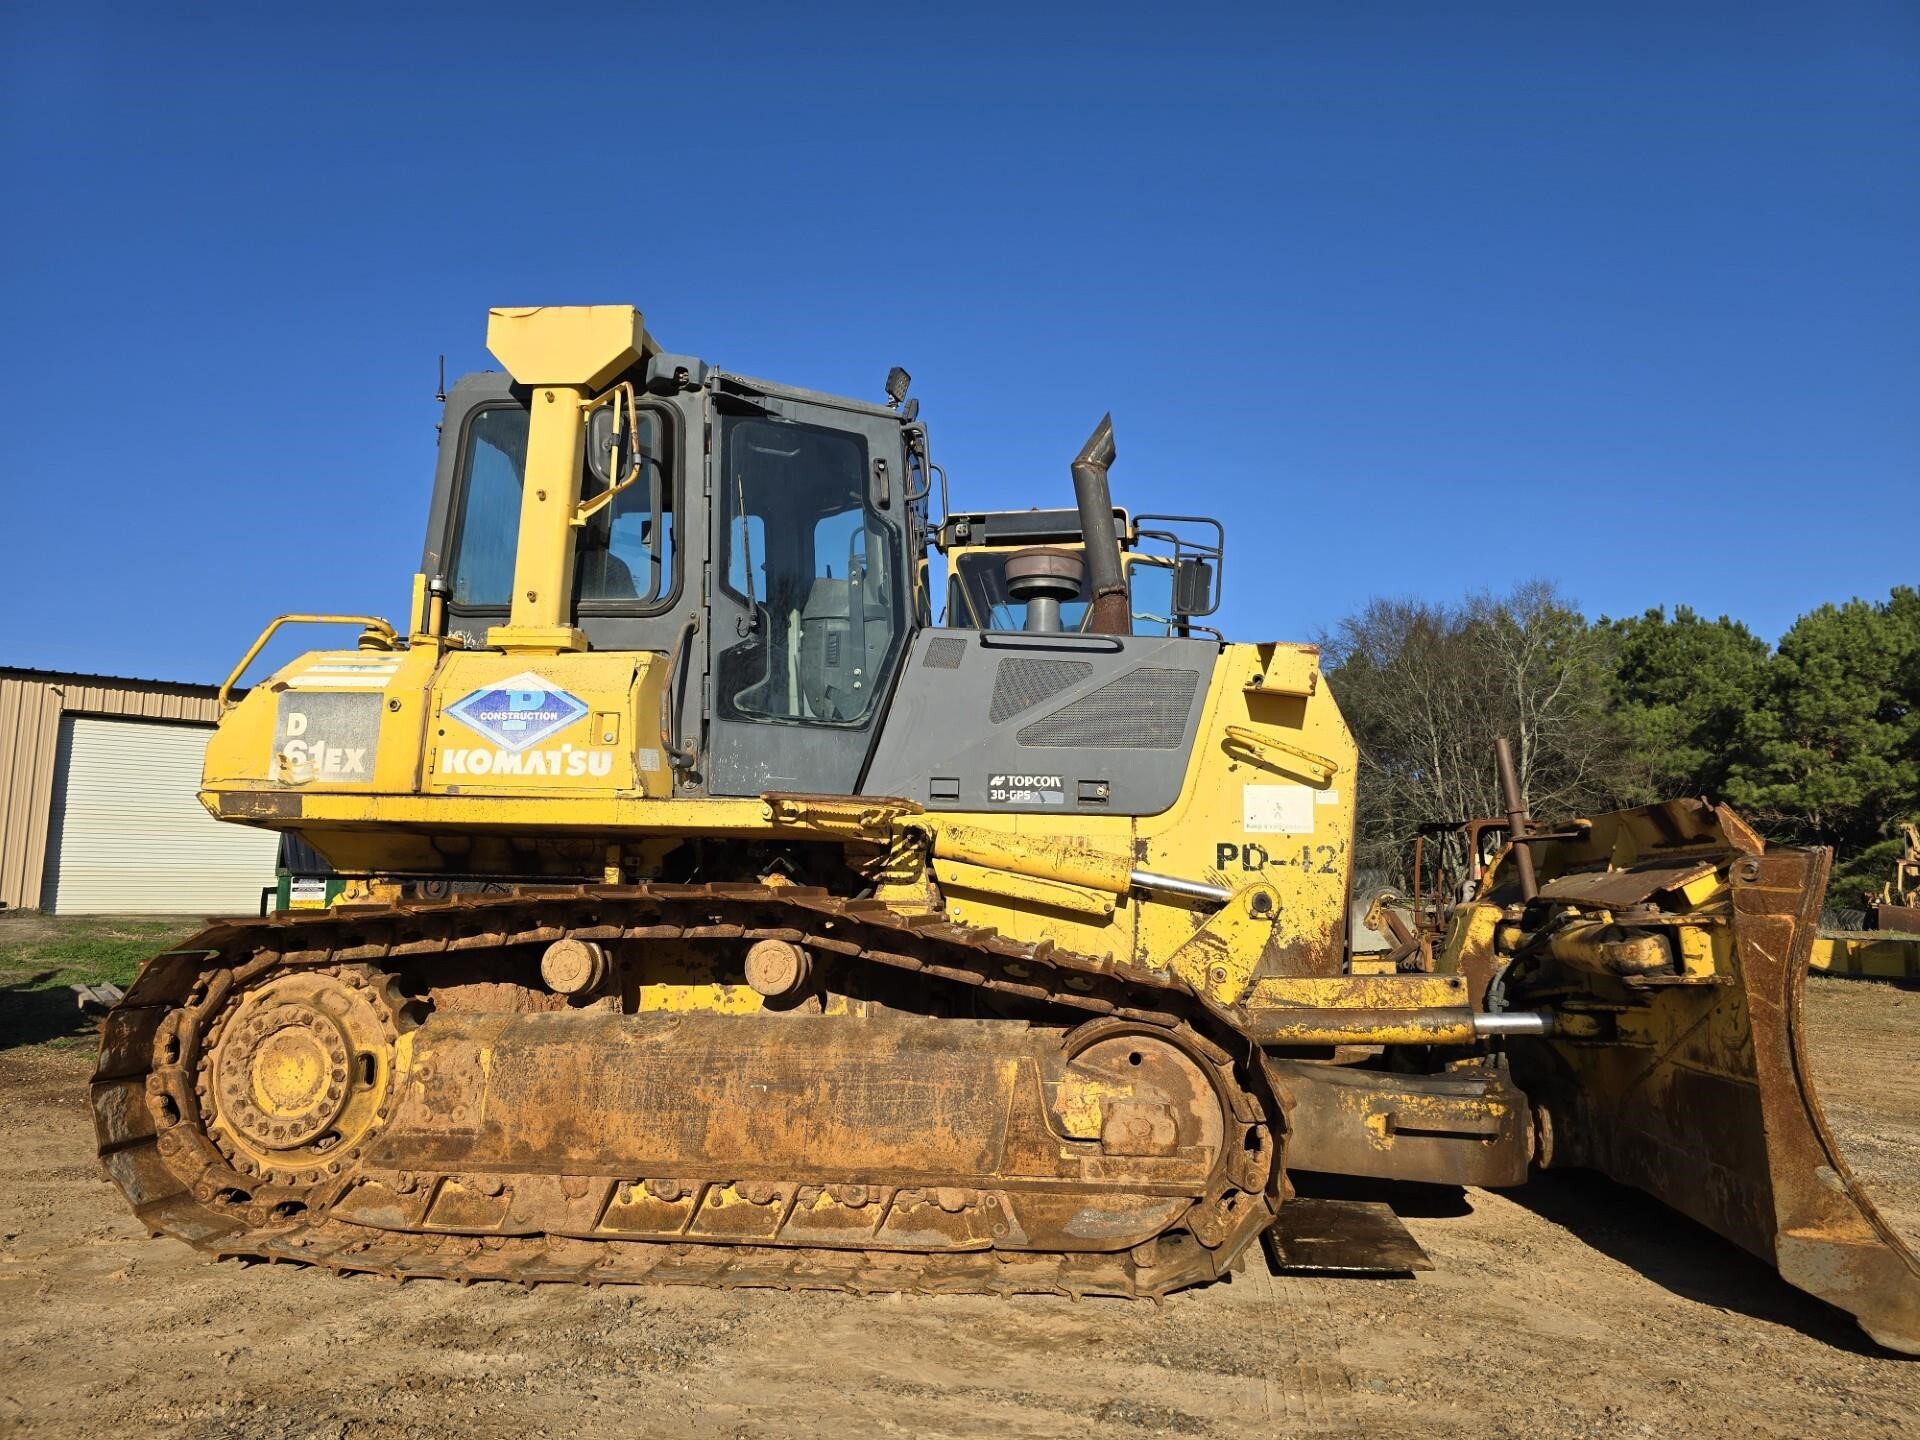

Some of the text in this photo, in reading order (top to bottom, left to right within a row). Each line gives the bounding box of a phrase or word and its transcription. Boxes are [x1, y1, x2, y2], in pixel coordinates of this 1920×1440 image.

[286, 712, 308, 737] D
[480, 711, 558, 721] CONSTRUCTION
[283, 739, 367, 773] 61EX
[441, 745, 613, 777] KOMATSU
[1006, 775, 1062, 787] TOPCON
[990, 789, 1031, 800] 3D-GPS
[1216, 842, 1338, 874] PD-42
